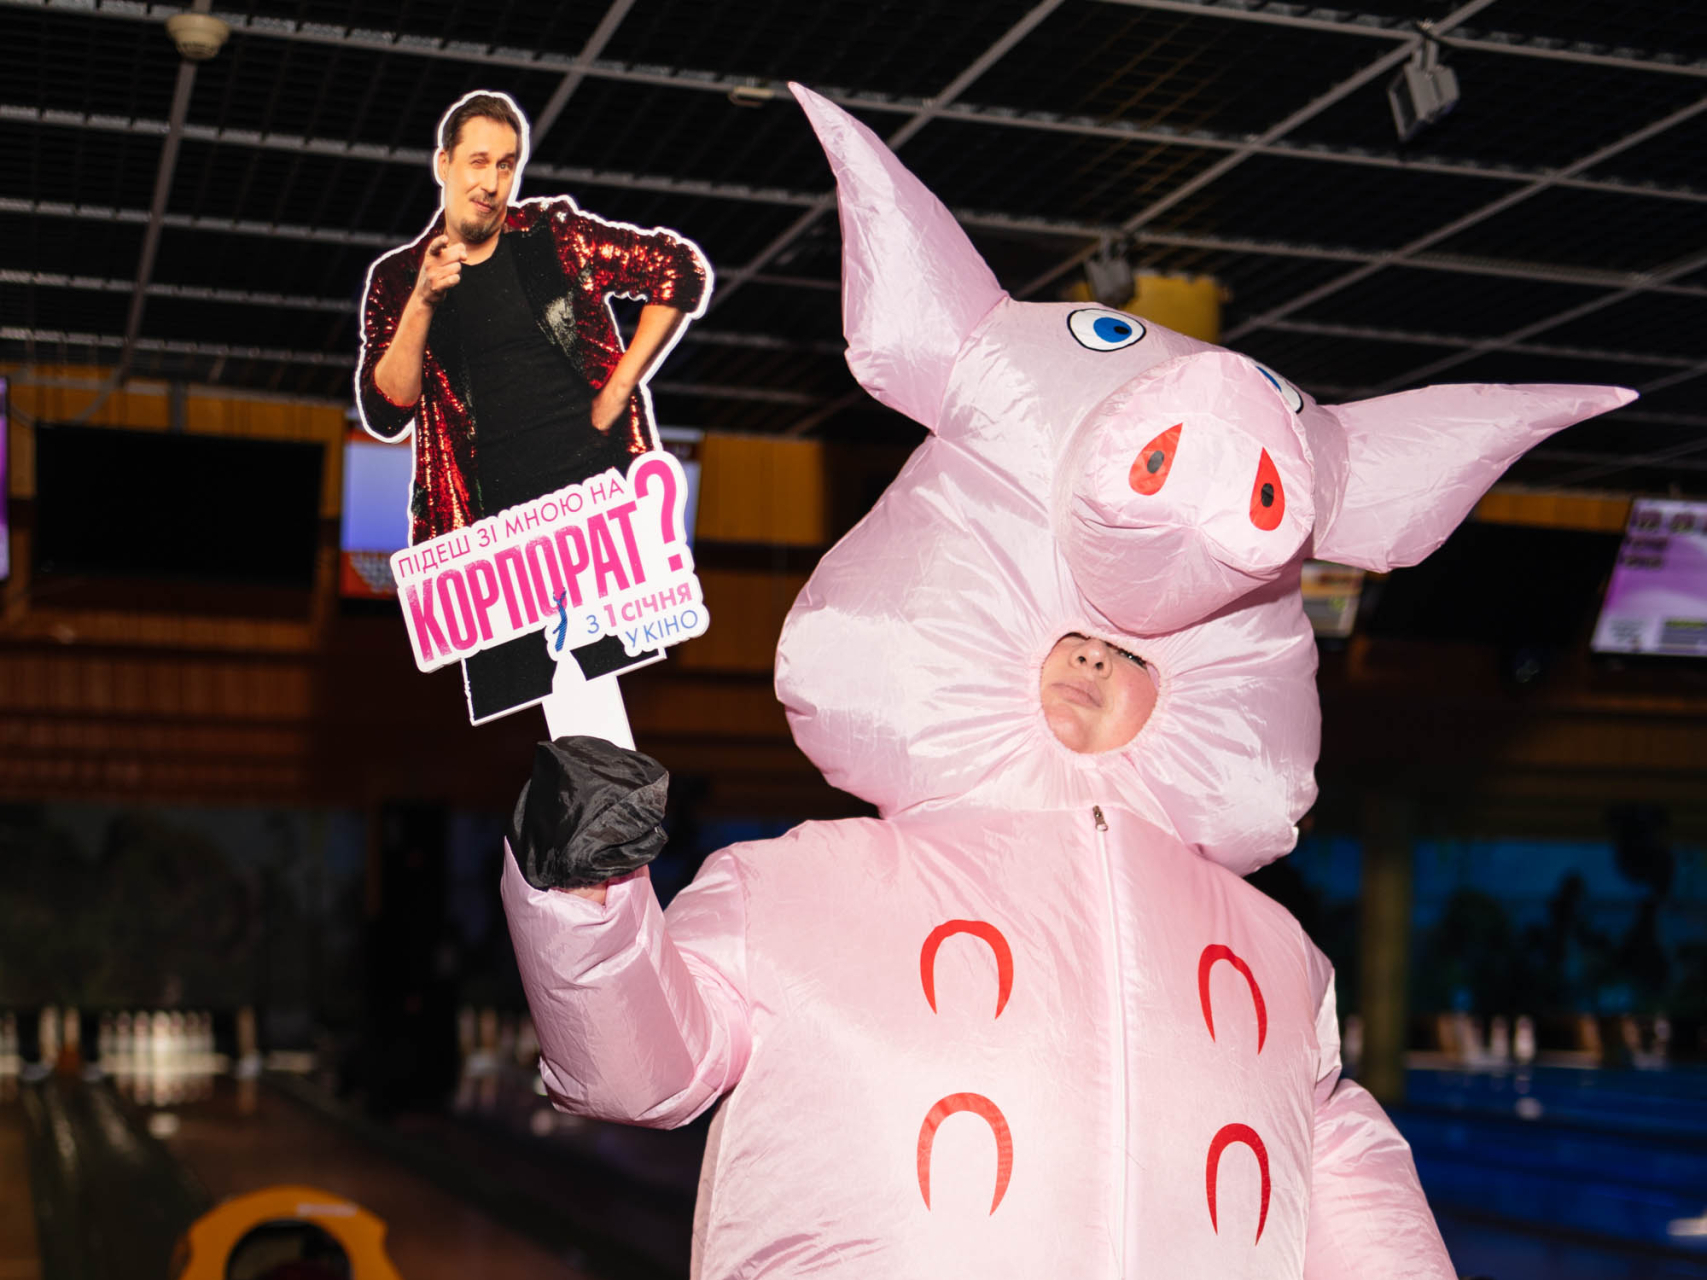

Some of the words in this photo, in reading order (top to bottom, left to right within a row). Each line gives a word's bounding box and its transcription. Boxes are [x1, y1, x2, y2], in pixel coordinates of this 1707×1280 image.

[398, 535, 472, 579] ПІДЕШ
[478, 523, 499, 549] ЗІ
[504, 492, 584, 539] МНОЮ
[589, 477, 626, 505] НА
[620, 581, 694, 622] СІЧНЯ
[643, 609, 699, 643] КІНО
